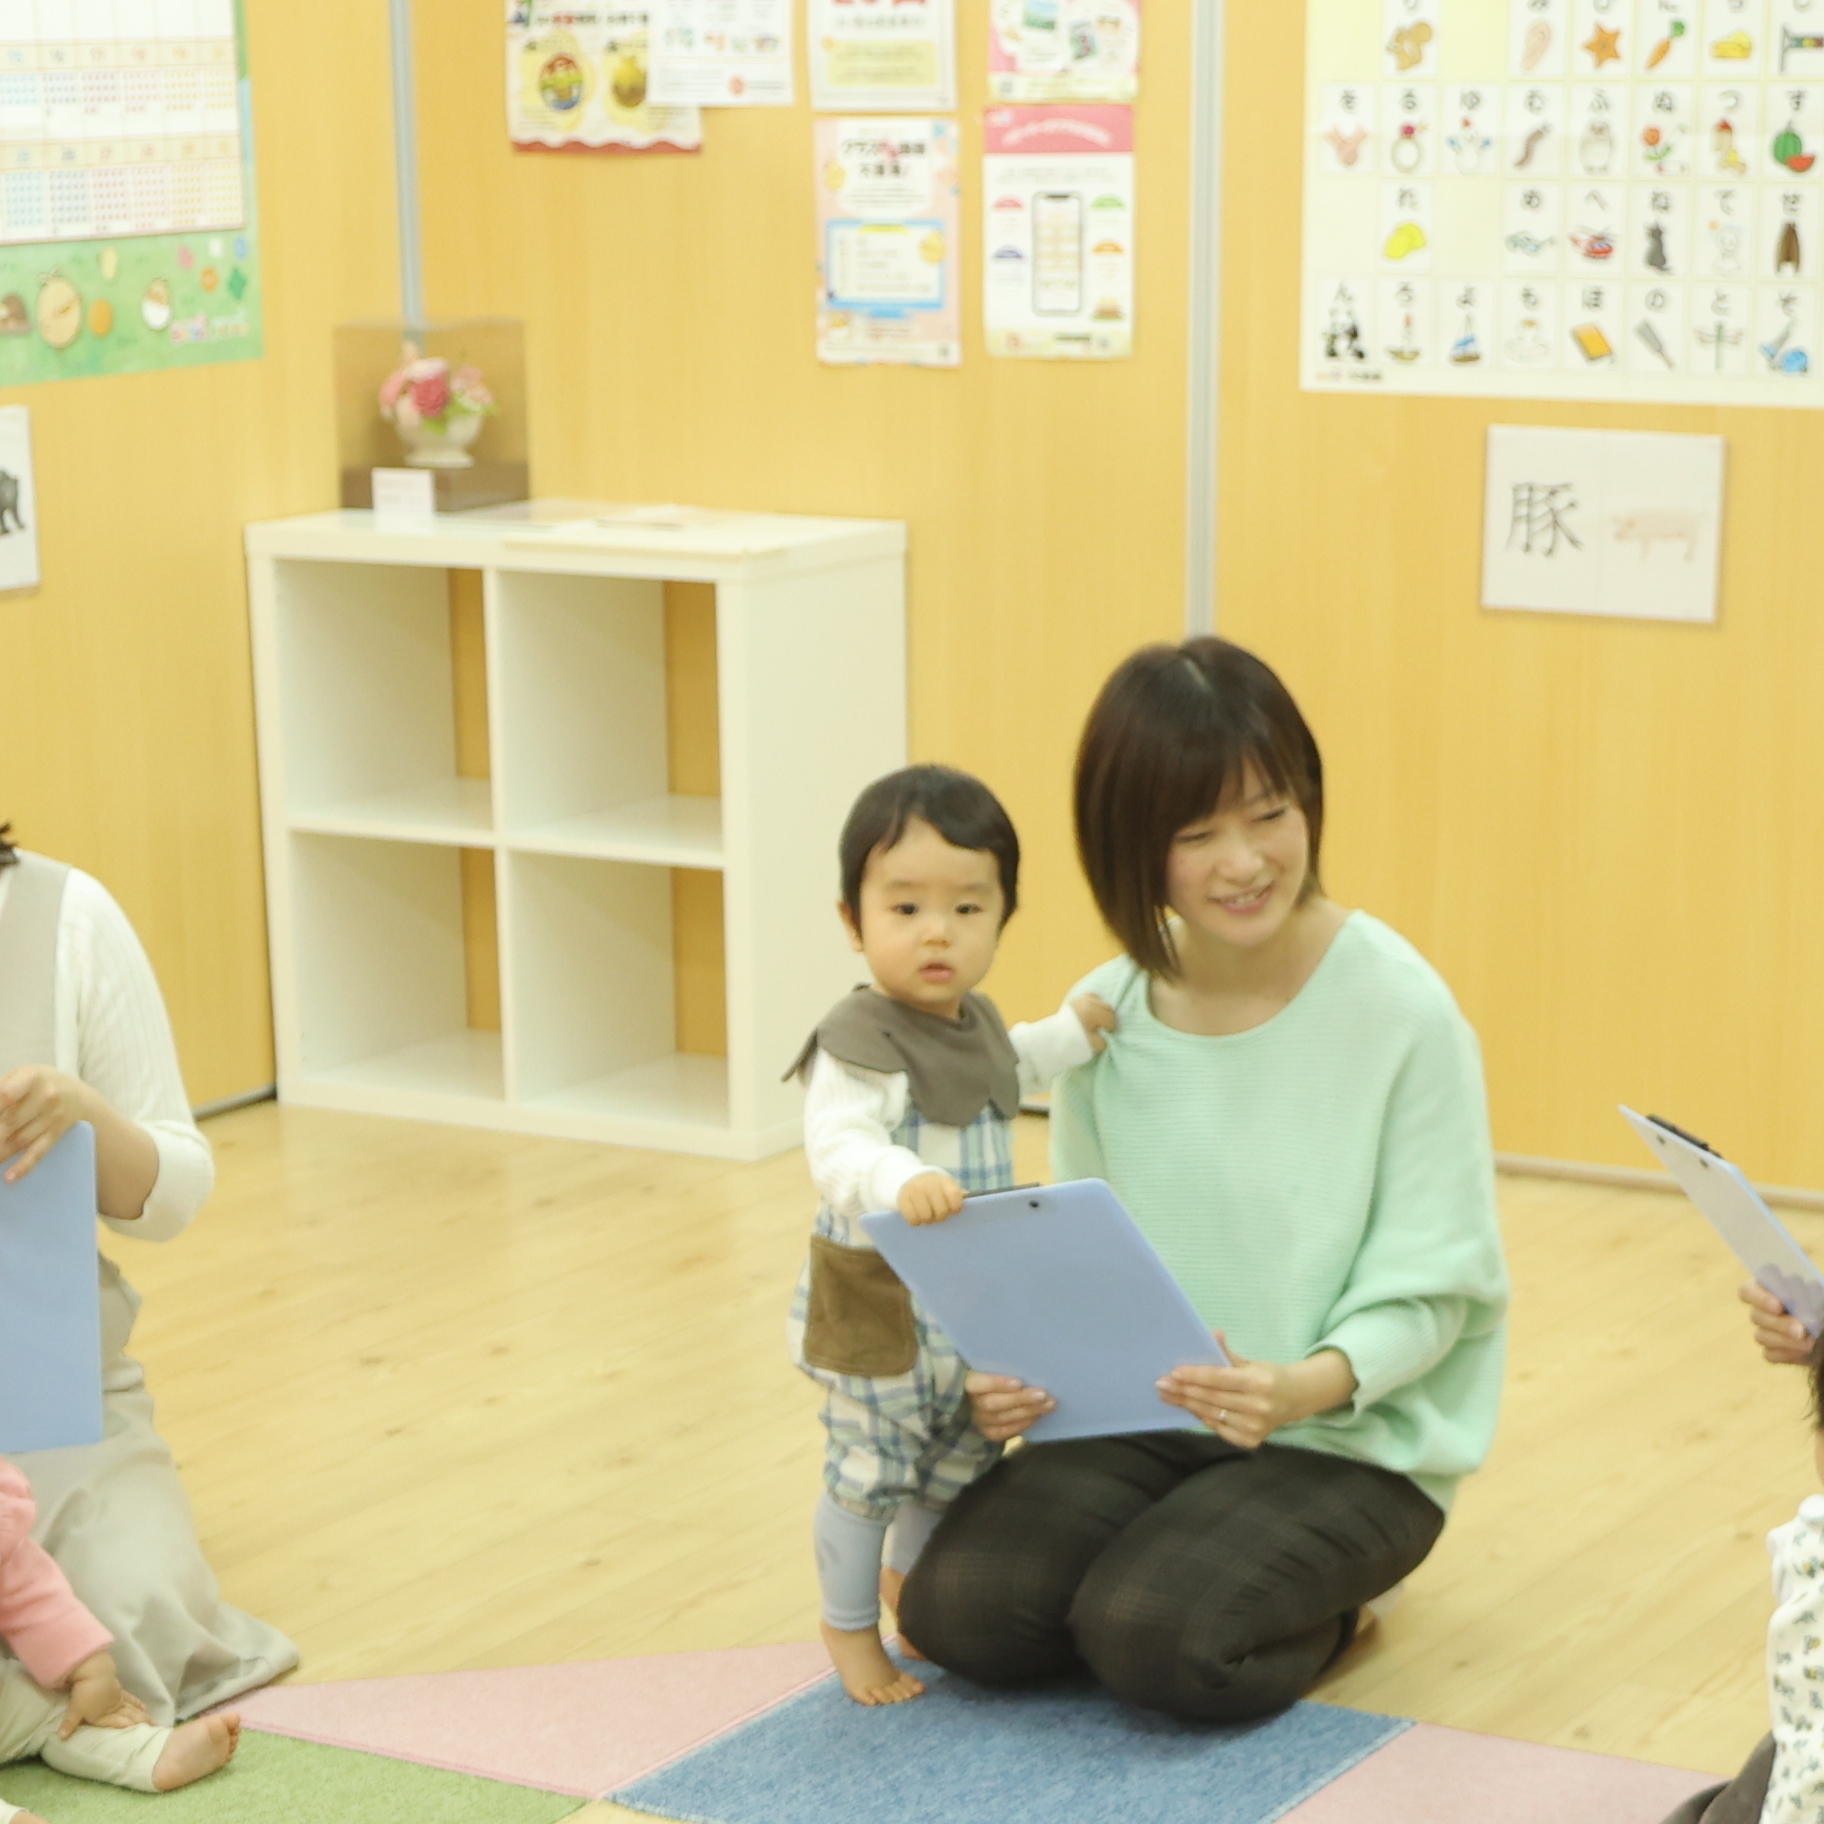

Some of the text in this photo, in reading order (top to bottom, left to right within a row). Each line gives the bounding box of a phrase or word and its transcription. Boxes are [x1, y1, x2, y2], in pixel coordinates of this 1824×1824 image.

[1718, 89, 1739, 110] つ
[1585, 189, 1608, 210] へ
[1715, 189, 1736, 215] て
[1645, 288, 1667, 312] の
[1711, 289, 1731, 315] と
[1506, 481, 1583, 558] 豚
